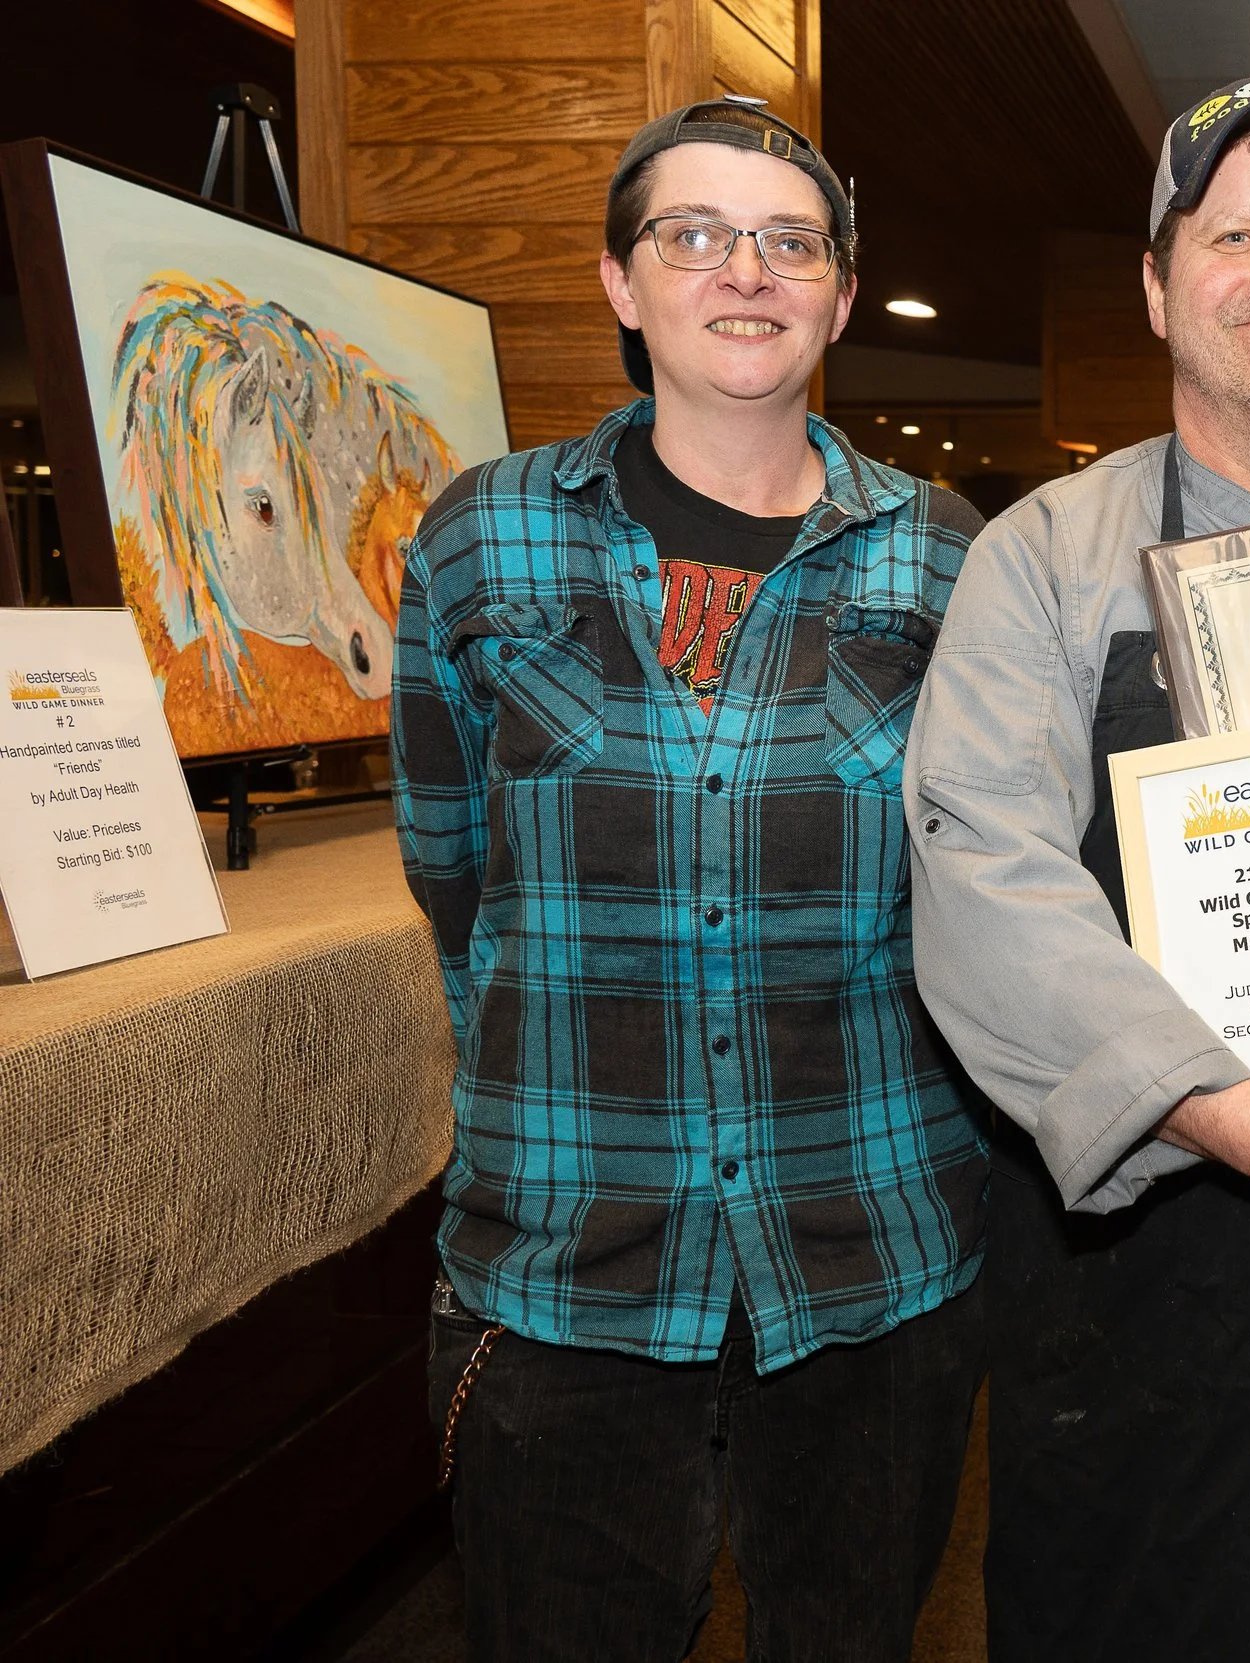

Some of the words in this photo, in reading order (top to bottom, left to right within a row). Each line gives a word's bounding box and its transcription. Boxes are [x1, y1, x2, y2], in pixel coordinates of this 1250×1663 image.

[26, 669, 97, 684] easterseals
[61, 685, 101, 696] Bluegrass
[13, 701, 39, 710] WILD
[41, 699, 68, 709] GAME
[70, 698, 105, 707] DINNER
[56, 716, 65, 728] #
[66, 715, 75, 728] 2
[0, 744, 73, 758] Handpainted
[75, 739, 114, 753] canvas
[115, 736, 141, 749] titled
[31, 792, 46, 807] by
[49, 788, 79, 803] Adult
[80, 785, 102, 800] Day
[104, 781, 140, 796] Health
[53, 828, 91, 842] Value:
[92, 821, 142, 838] Priceless
[1184, 834, 1235, 854] WILD
[56, 852, 102, 870] Starting
[102, 847, 125, 862] Bid:
[125, 842, 153, 858] $100
[99, 889, 146, 905] easterseals
[1199, 893, 1241, 914] Wild
